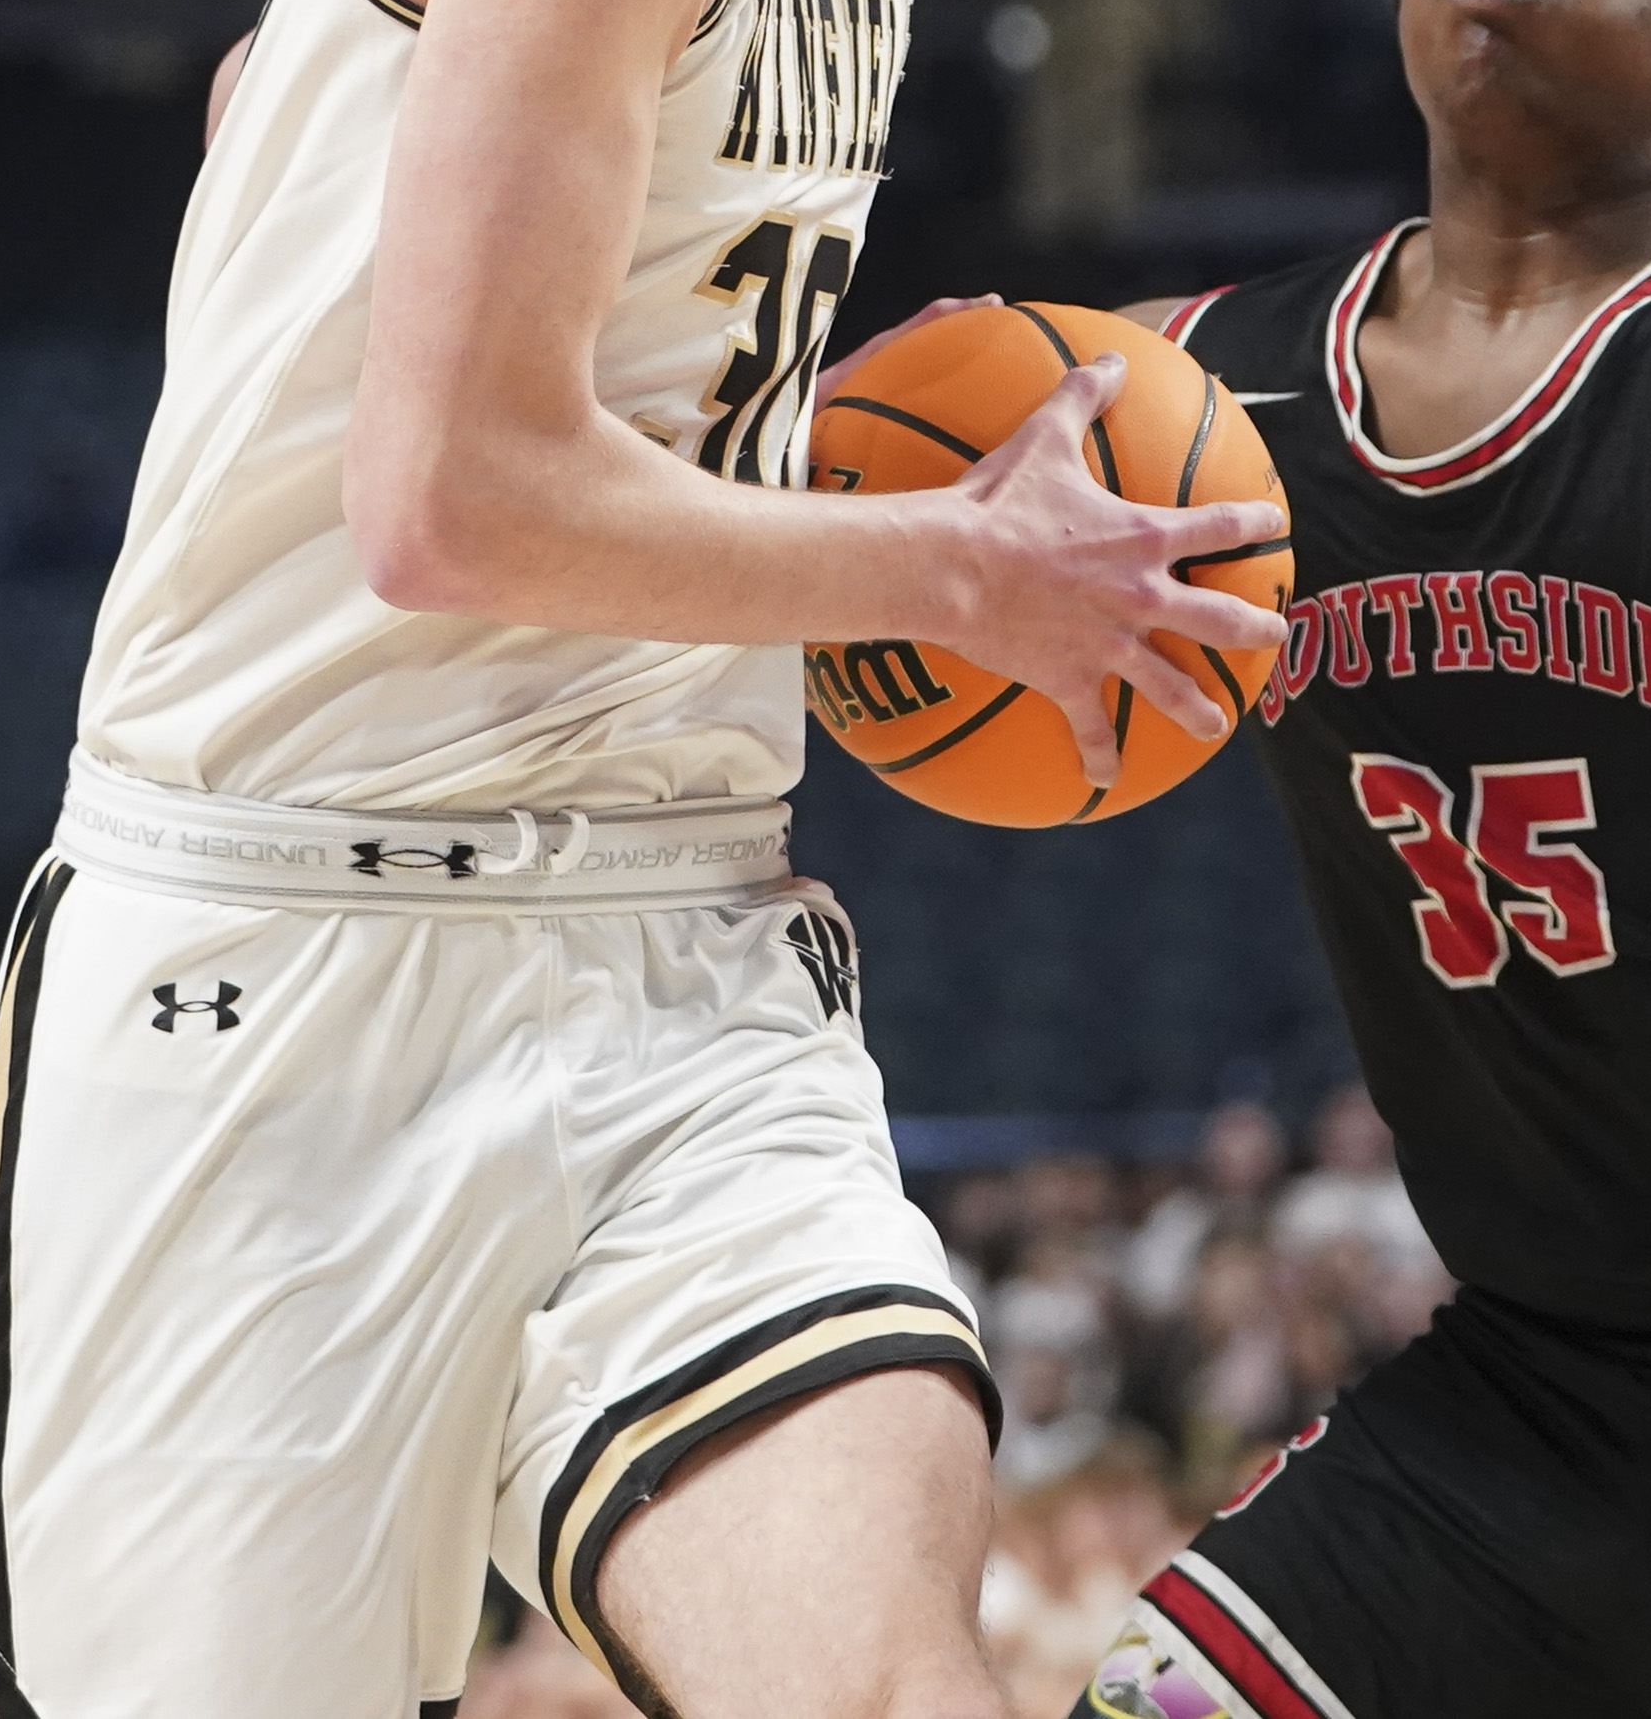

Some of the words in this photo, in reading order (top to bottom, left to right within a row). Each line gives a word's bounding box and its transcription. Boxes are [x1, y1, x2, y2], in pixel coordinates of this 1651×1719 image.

[804, 639, 956, 734] Wil
[181, 831, 328, 866] UNDER
[691, 834, 779, 866] UNDER
[1350, 752, 1618, 990] 35
